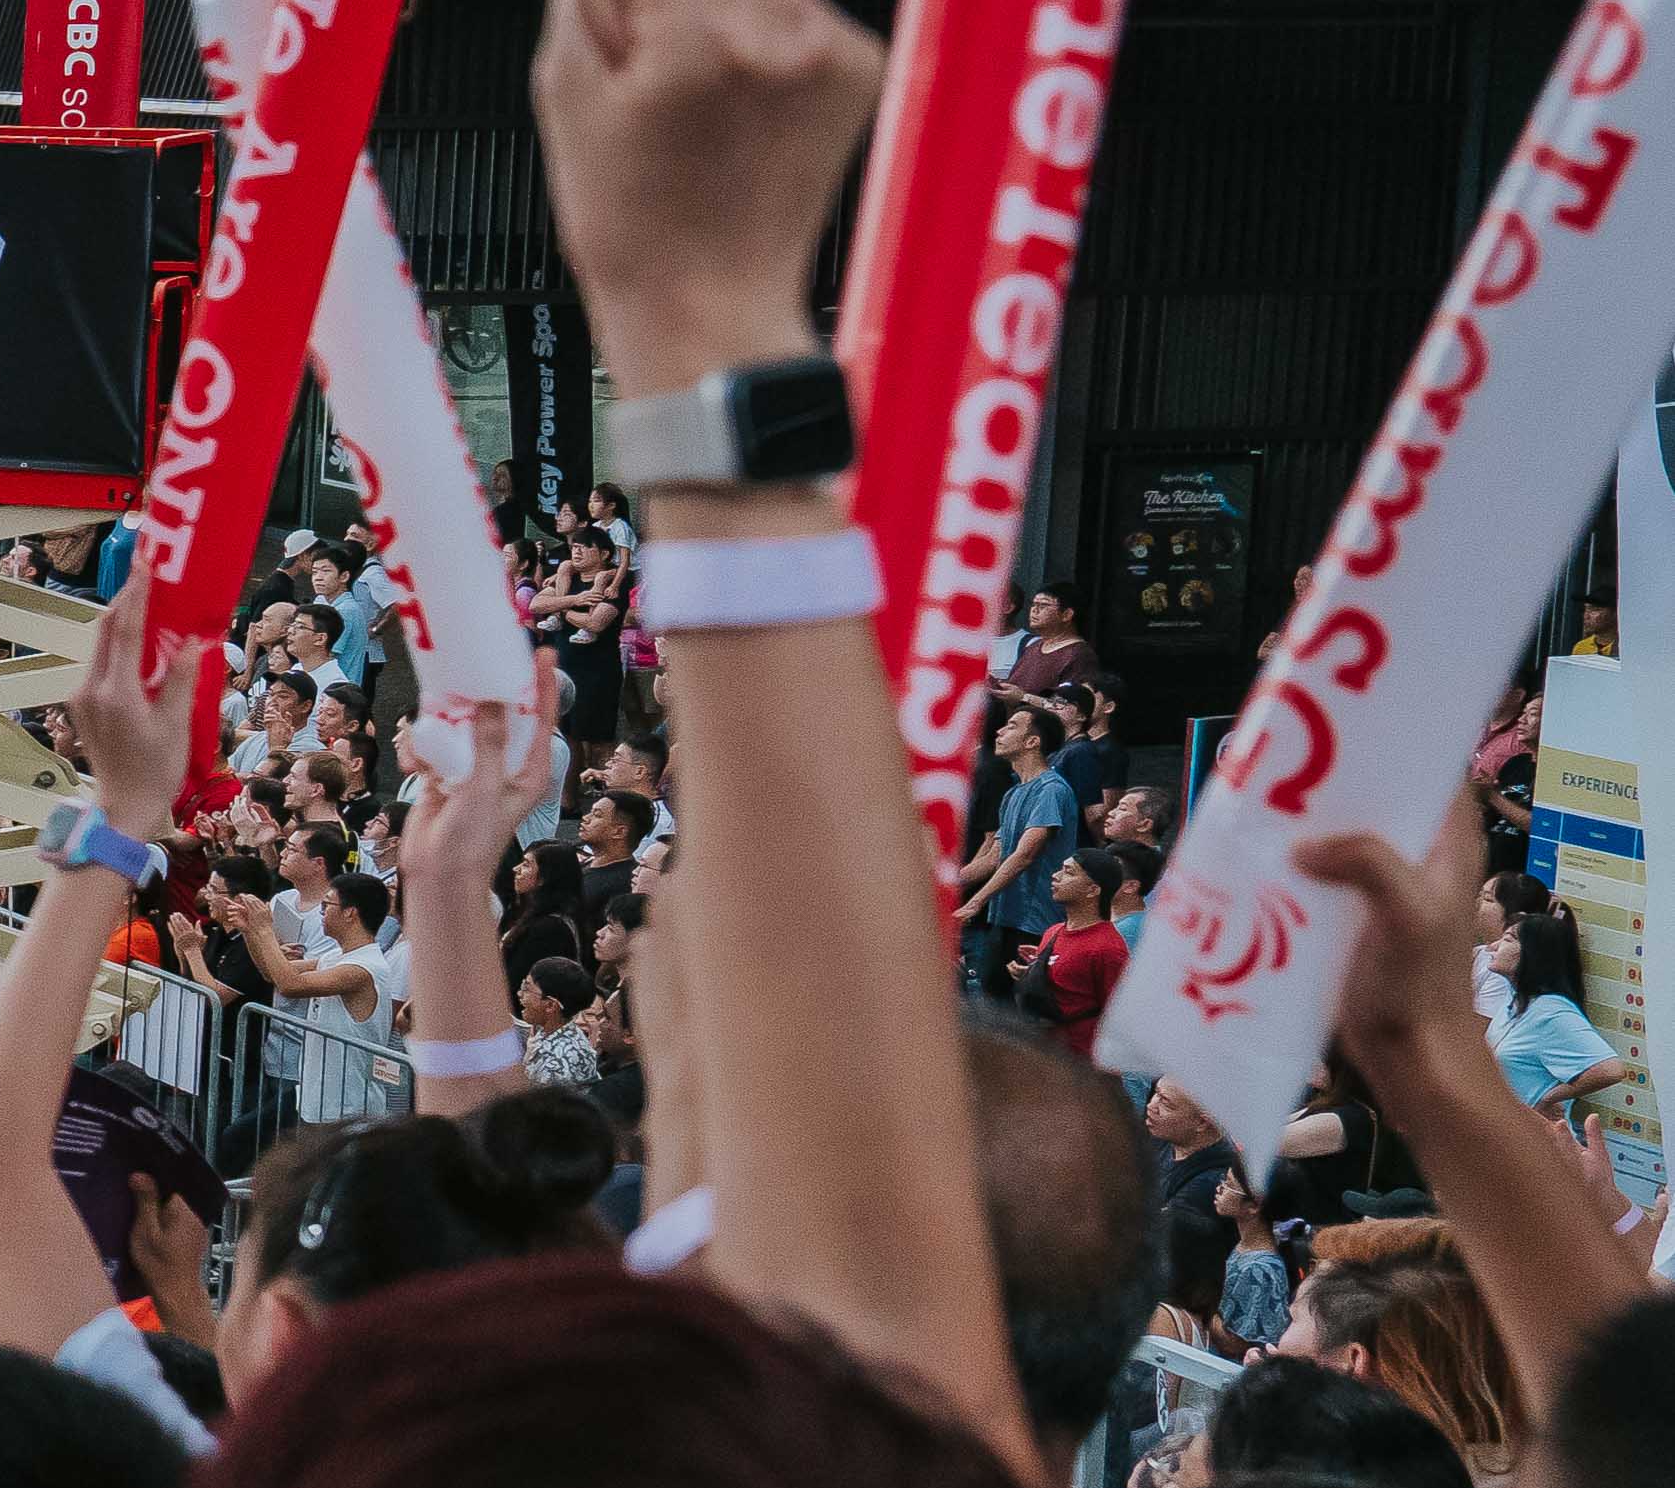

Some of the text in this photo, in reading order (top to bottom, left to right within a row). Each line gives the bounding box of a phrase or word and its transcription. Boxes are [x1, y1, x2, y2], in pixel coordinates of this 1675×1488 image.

[536, 363, 558, 457] Power
[538, 463, 564, 515] Key
[1144, 489, 1225, 505] The Kitchen
